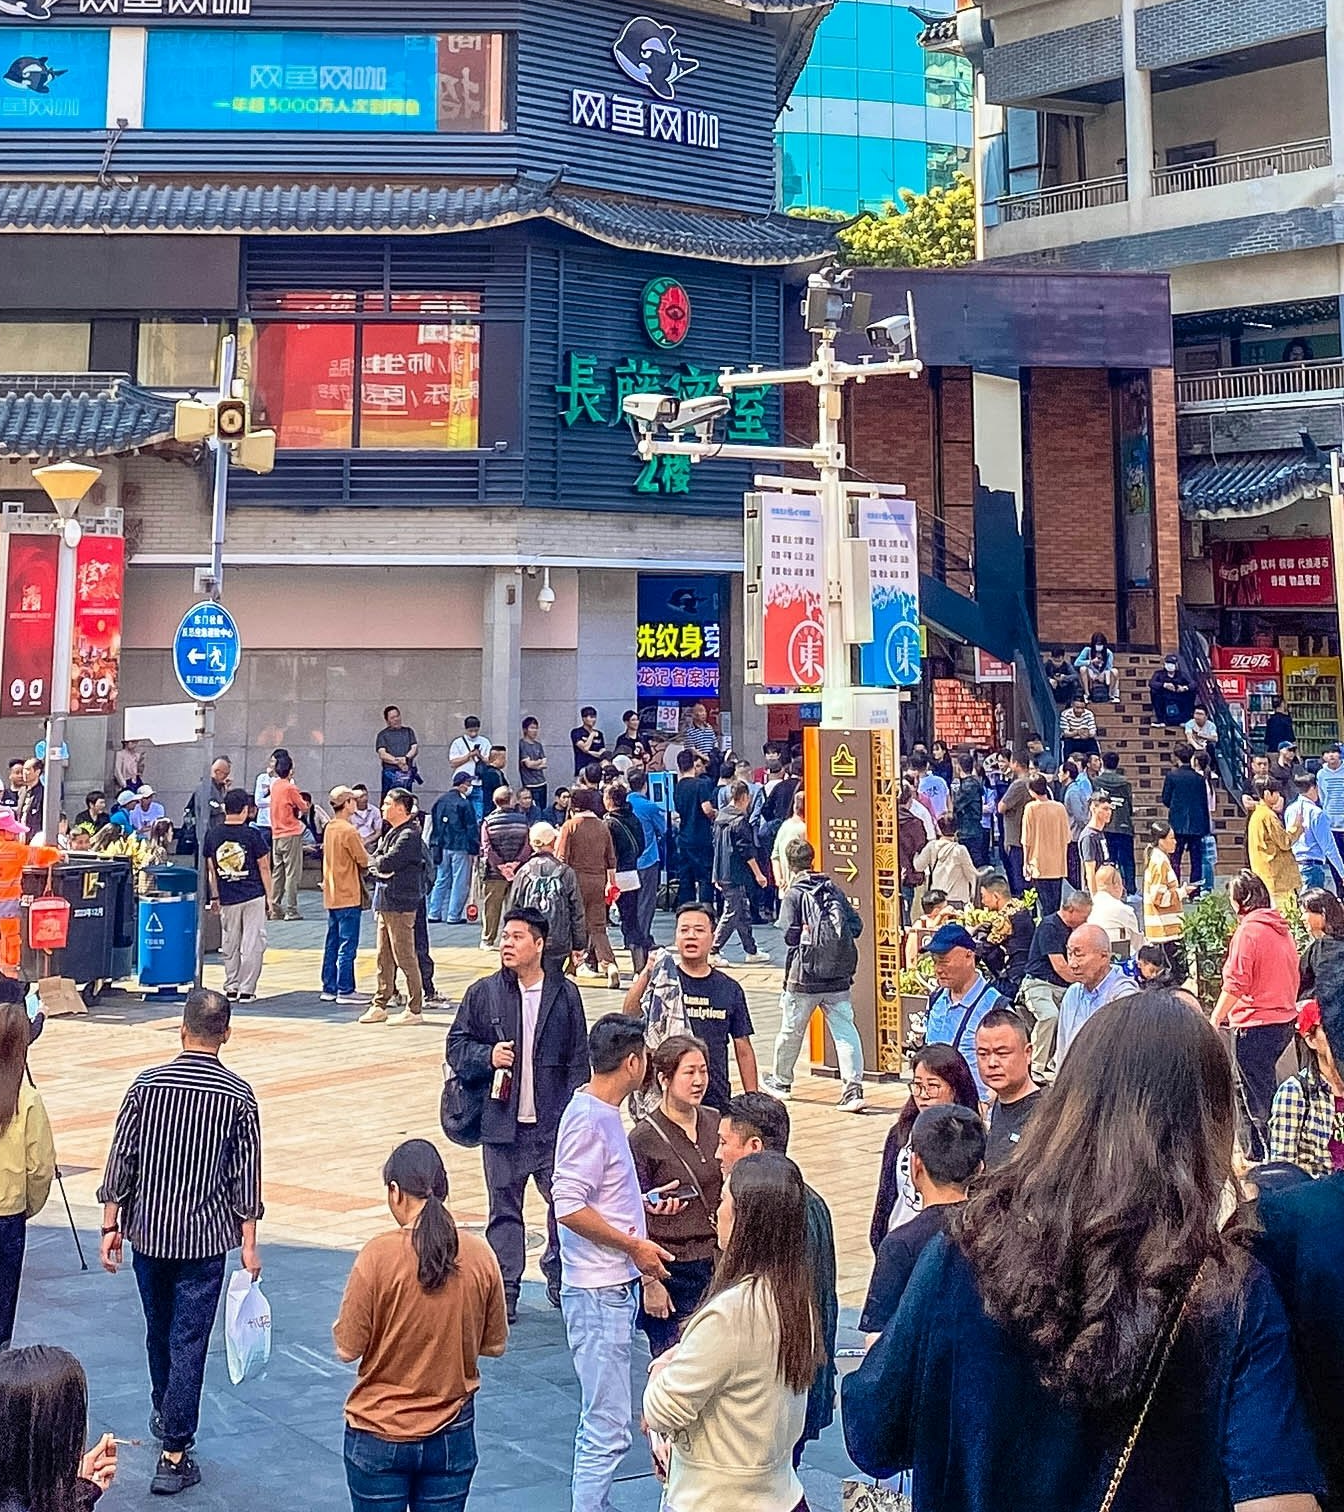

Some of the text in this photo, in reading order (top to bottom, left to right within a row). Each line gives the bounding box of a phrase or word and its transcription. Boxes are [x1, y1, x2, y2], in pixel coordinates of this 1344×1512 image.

[250, 64, 387, 91] 网鱼网咖
[571, 87, 720, 149] 网鱼网咖
